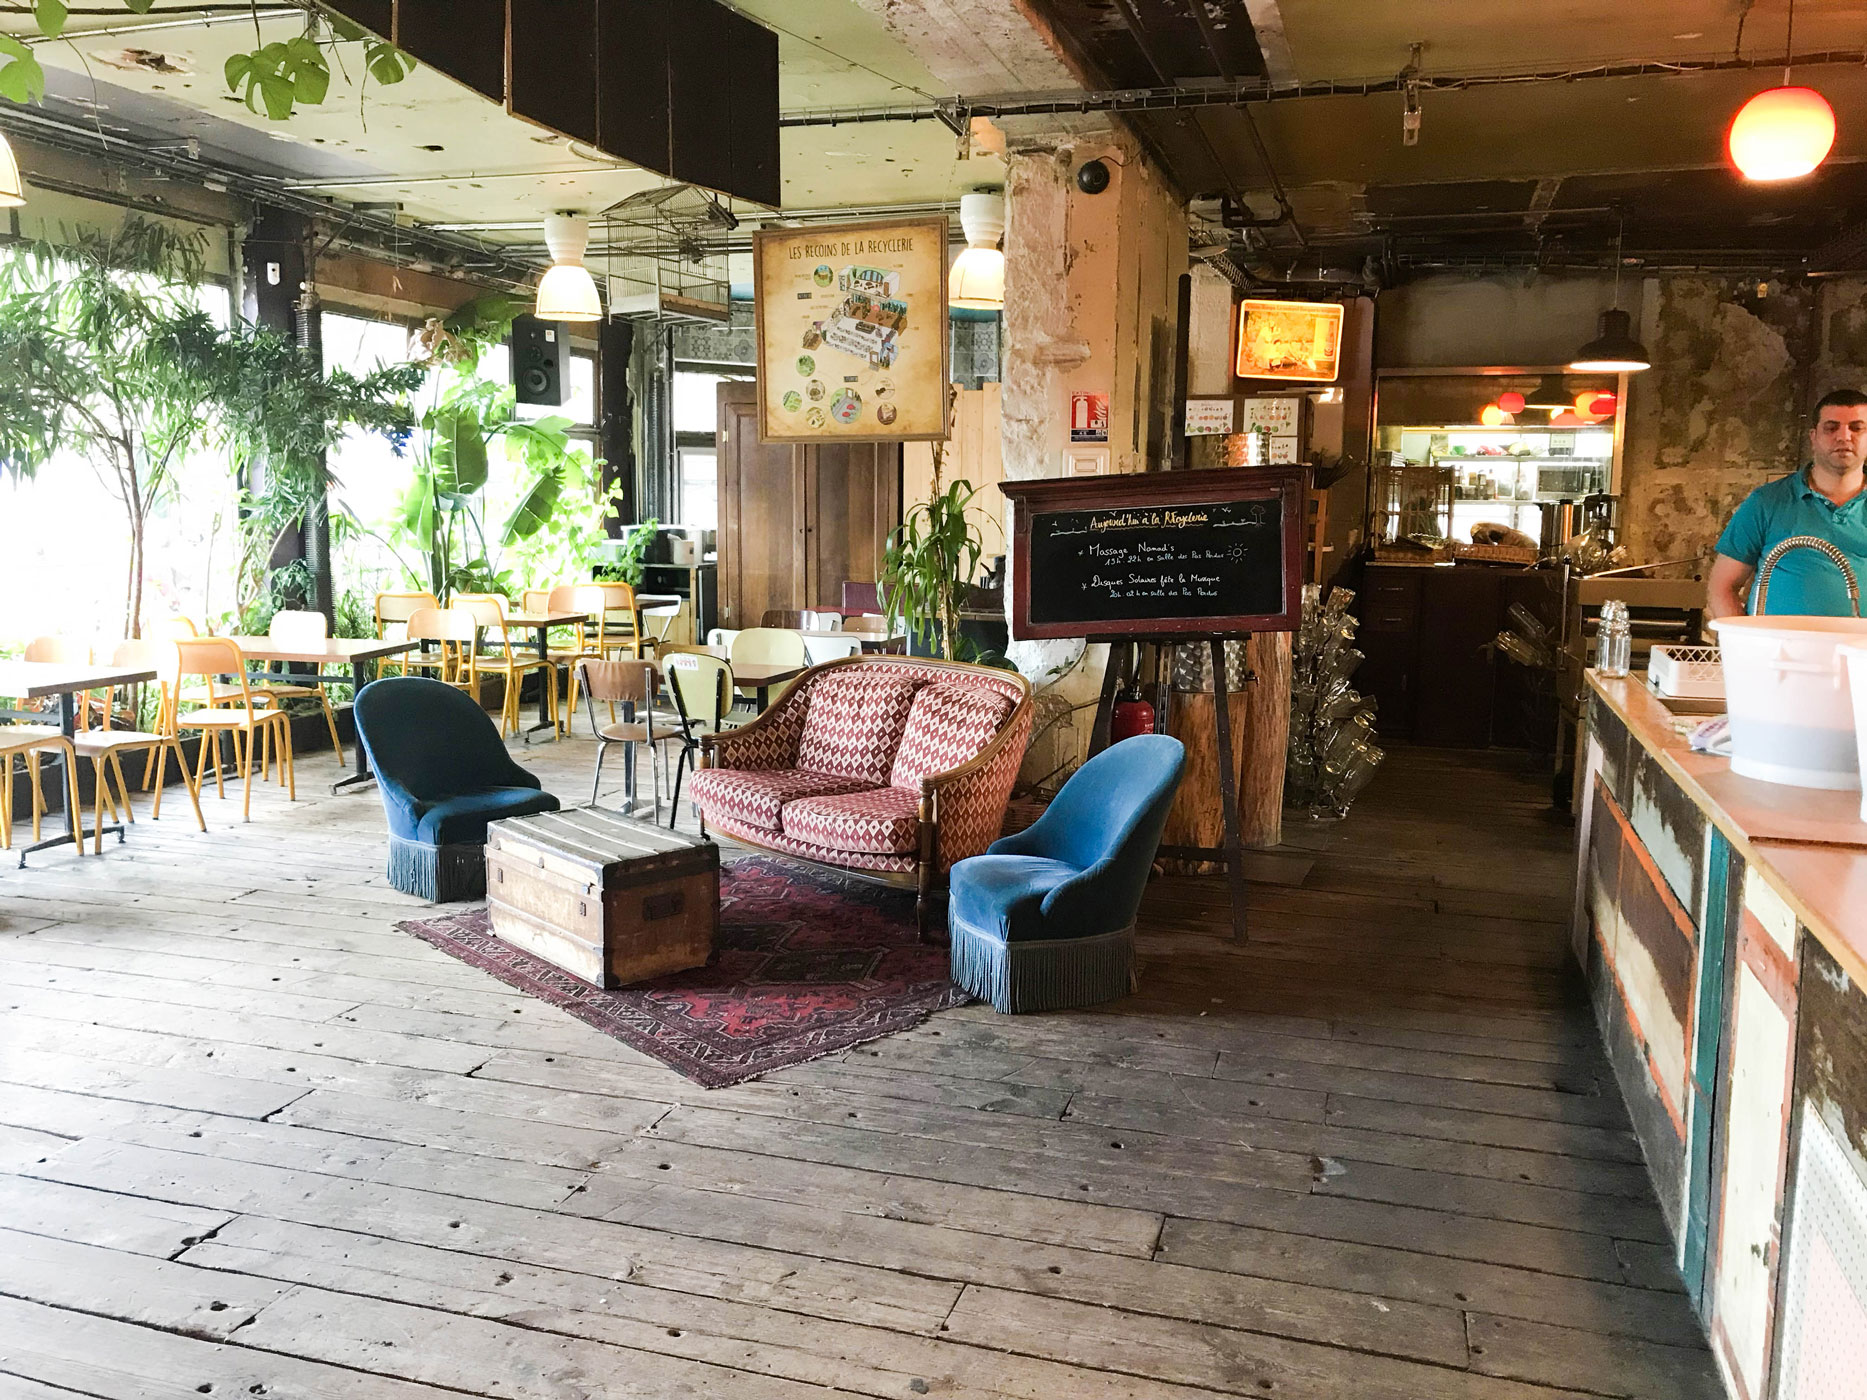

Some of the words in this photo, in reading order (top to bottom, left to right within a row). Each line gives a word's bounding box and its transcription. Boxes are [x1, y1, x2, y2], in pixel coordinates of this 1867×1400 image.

[788, 245, 802, 259] LES
[805, 243, 838, 258] RECOINS
[841, 242, 852, 256] DE
[855, 240, 864, 255] LA
[868, 237, 913, 254] RECYCLERIE
[1151, 512, 1160, 525] la
[1089, 543, 1128, 559] Massage
[1191, 550, 1202, 559] Pas
[1091, 574, 1123, 591] Disques
[1128, 573, 1157, 584] Solaires
[1178, 573, 1186, 584] la
[1190, 573, 1220, 586] Musique
[1182, 587, 1192, 596] Pas
